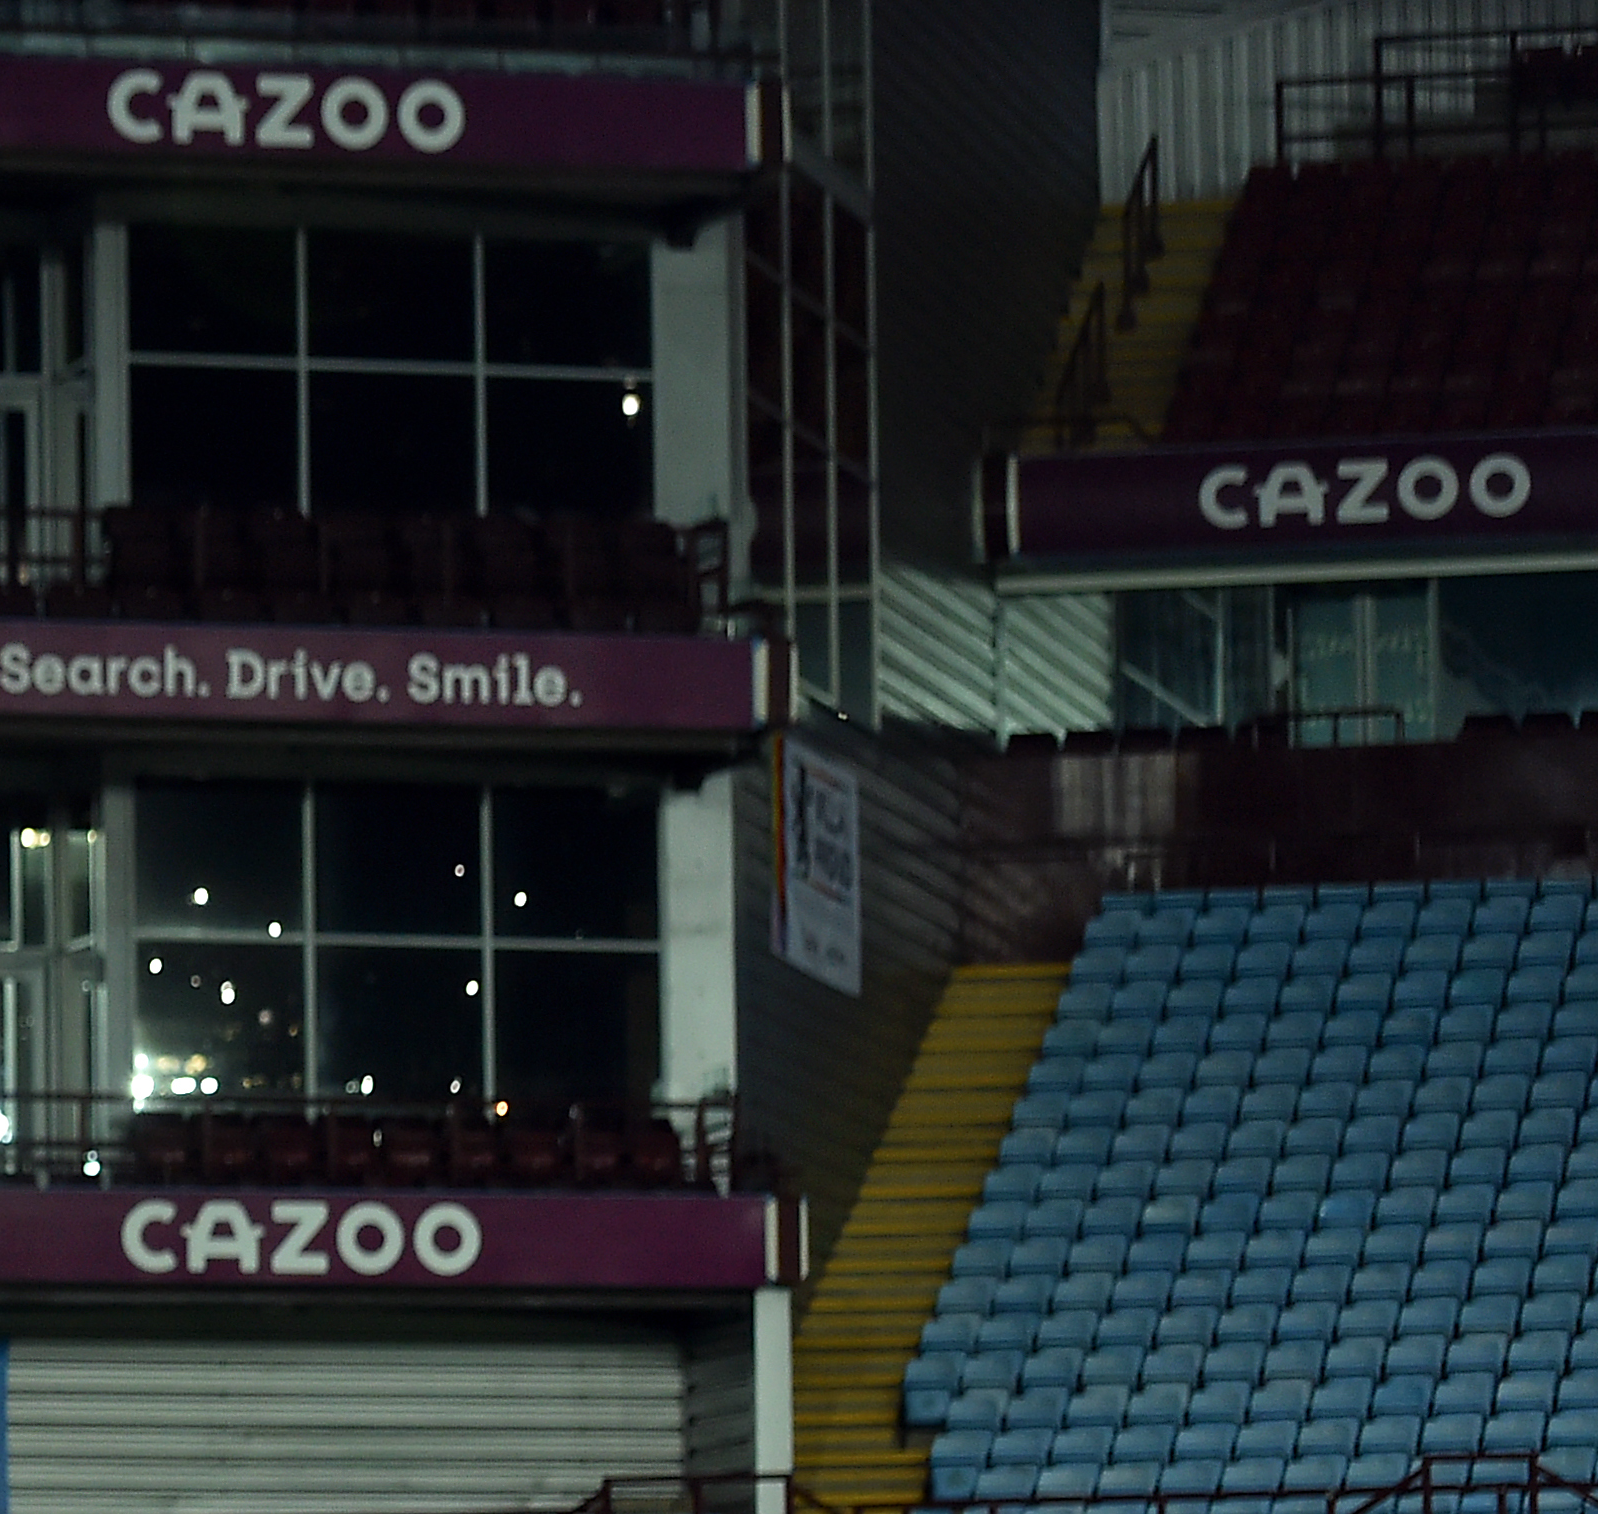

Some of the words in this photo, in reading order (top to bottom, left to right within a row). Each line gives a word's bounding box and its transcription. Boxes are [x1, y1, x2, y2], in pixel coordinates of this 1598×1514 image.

[106, 69, 466, 153] CAZOO
[1197, 453, 1532, 530] CAZOO
[224, 649, 392, 704] Drive.
[406, 653, 584, 709] Smile.
[120, 1199, 483, 1277] CAZOO
